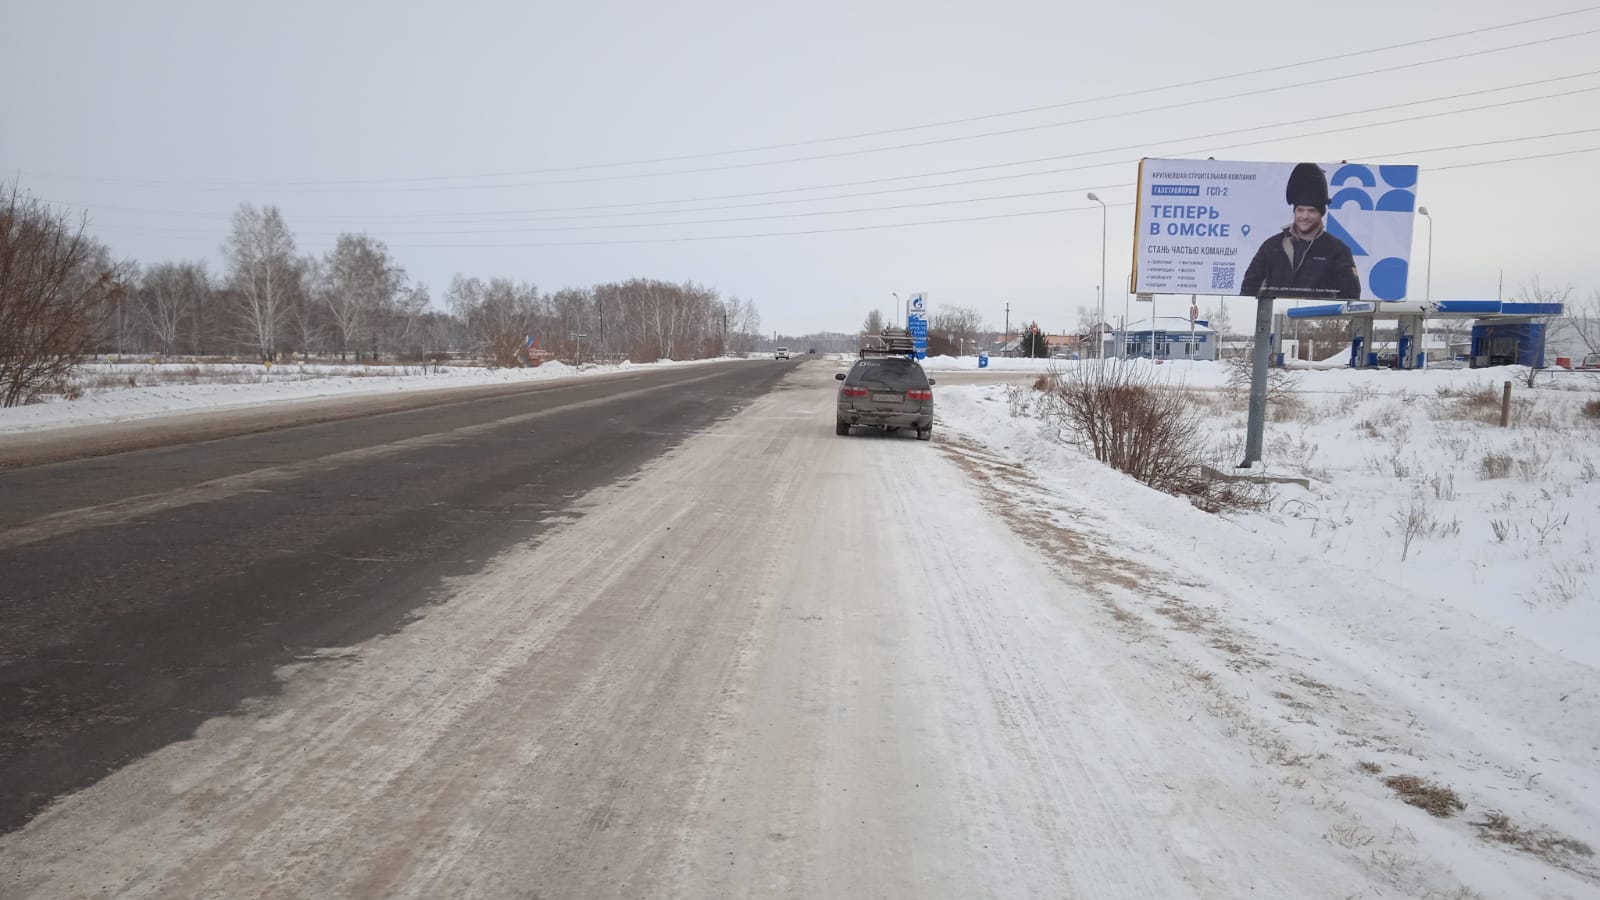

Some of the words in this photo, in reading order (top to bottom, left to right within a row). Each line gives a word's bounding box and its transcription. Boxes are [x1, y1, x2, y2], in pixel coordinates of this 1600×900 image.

[1206, 186, 1229, 197] ГСП-2
[1151, 205, 1220, 220] ТЕПЕРЬ
[1149, 222, 1161, 236] В
[1167, 222, 1230, 237] ОМСКЕ
[1147, 245, 1170, 254] СТАНЬ
[1171, 246, 1200, 255] ЧАСТЬЮ
[1200, 247, 1238, 256] КОМАНДЫ!
